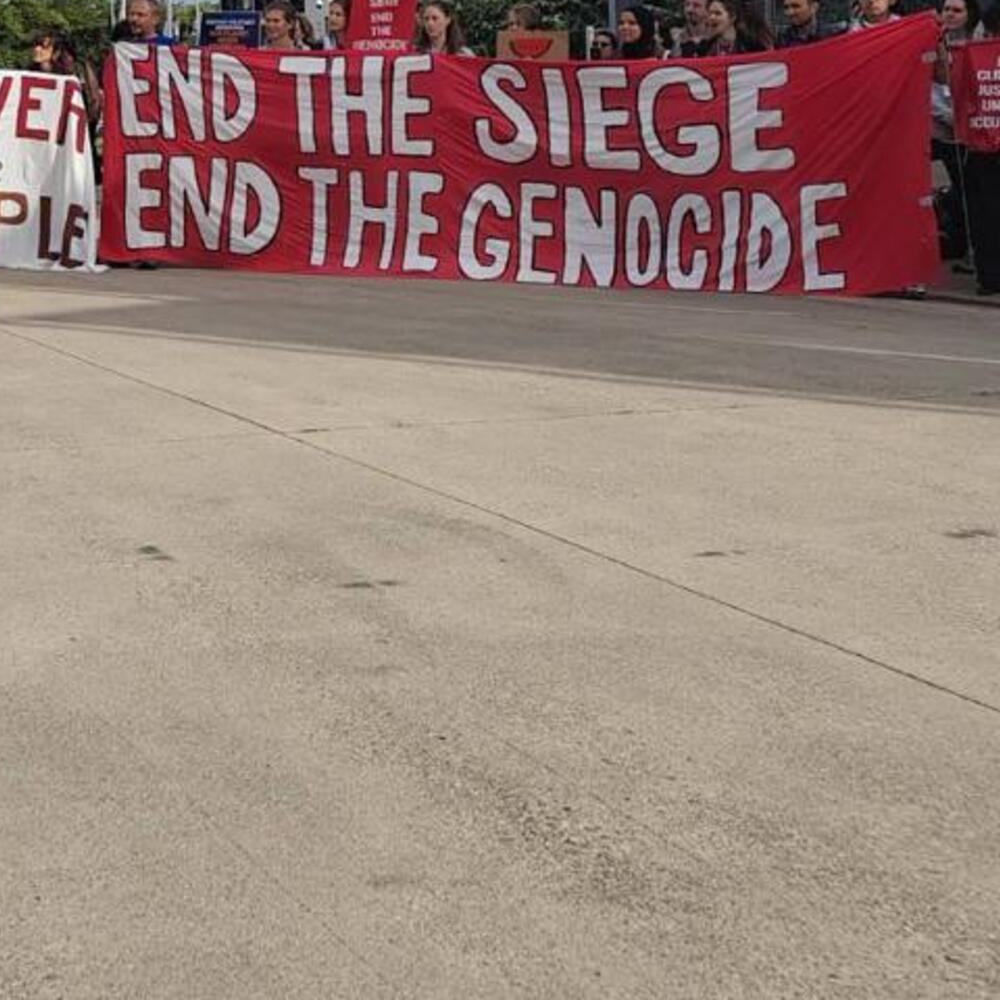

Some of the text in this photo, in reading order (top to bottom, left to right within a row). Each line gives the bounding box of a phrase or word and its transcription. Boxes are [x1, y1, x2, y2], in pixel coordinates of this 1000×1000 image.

[113, 41, 797, 176] END THE SIEGE
[124, 152, 849, 294] END THE GENOCIDE
